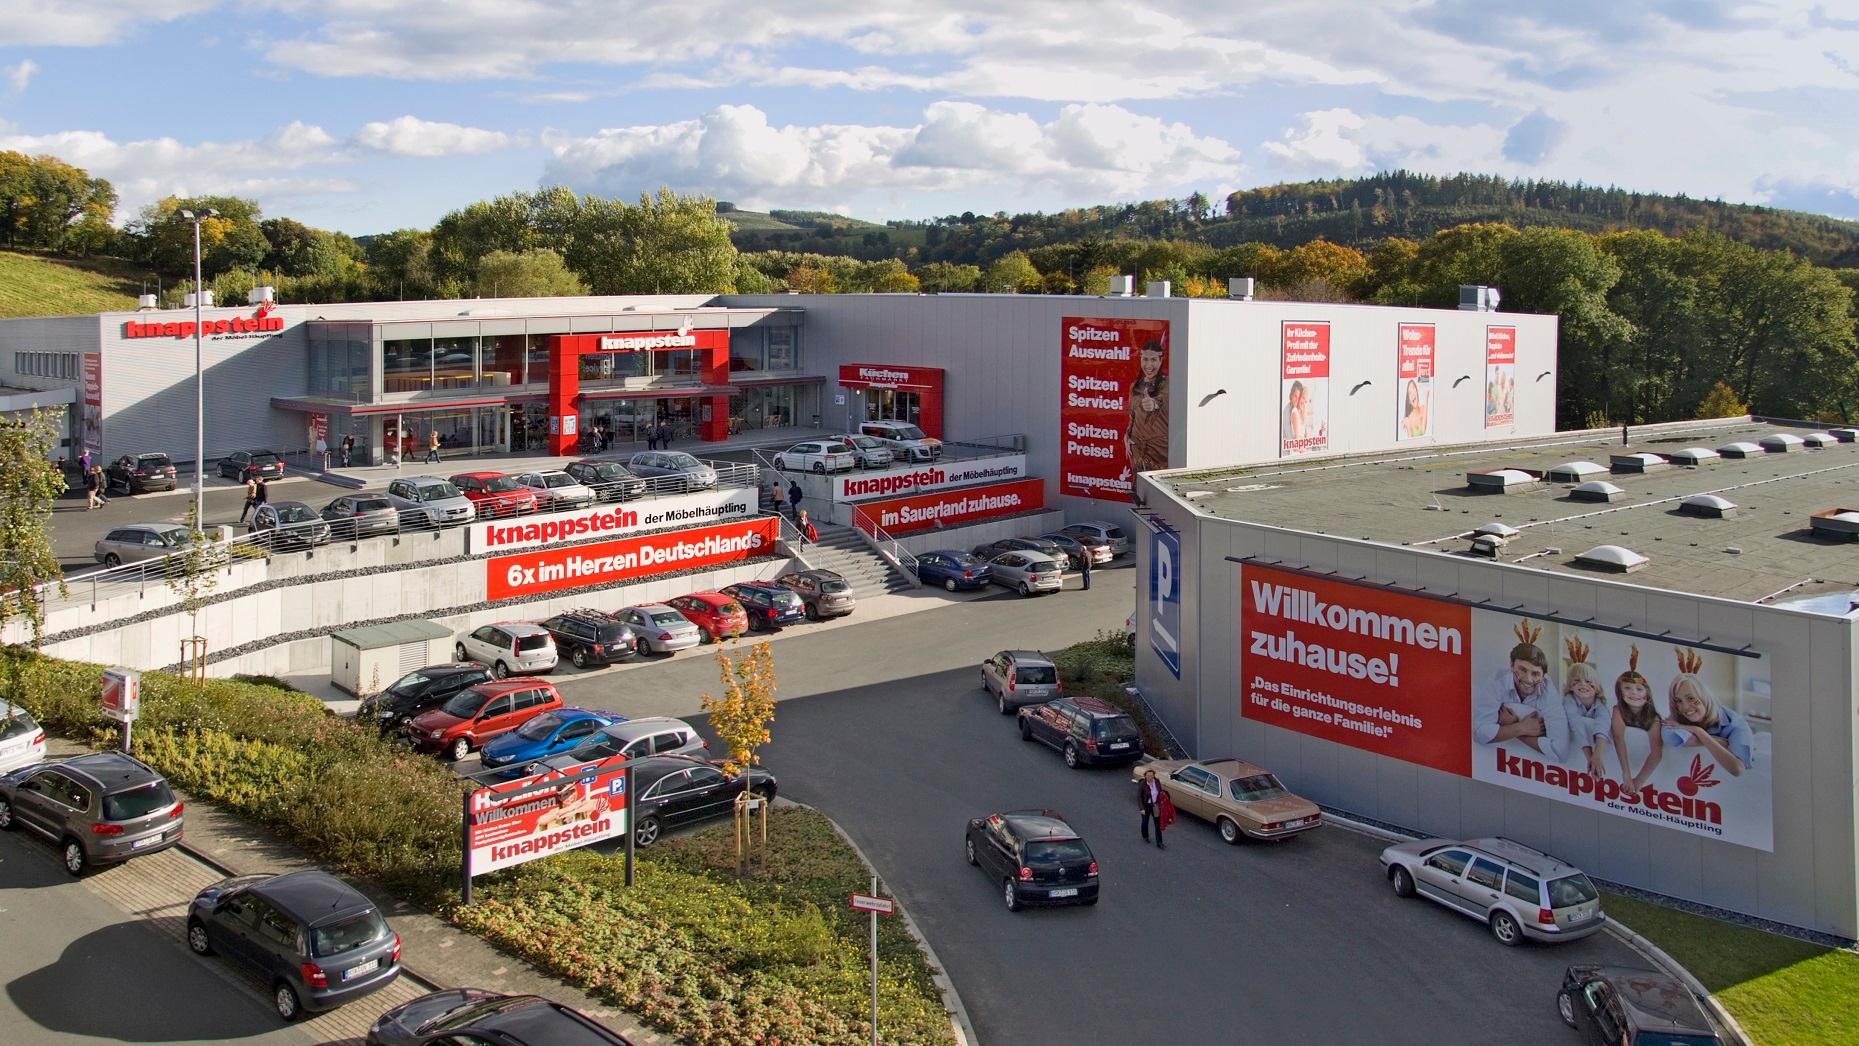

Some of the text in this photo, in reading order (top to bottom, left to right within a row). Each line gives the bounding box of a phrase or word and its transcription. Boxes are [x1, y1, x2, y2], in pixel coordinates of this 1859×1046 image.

[126, 308, 284, 338] knappstein
[1068, 326, 1119, 342] Spitzen
[601, 327, 696, 351] knappstein
[1068, 344, 1130, 360] Auswahl!
[859, 368, 908, 379] Küchen
[1068, 375, 1118, 391] Spitzen
[1068, 393, 1123, 410] Service!
[1068, 422, 1118, 440] Spitzen
[1283, 433, 1326, 449] knappstein
[1067, 441, 1114, 459] Preise!
[844, 465, 1018, 496] knappstein der Möbelhäuptling
[1067, 472, 1132, 490] knappstein
[486, 502, 746, 546] knappstein der Möbelhäuptling
[881, 493, 1021, 527] im Sauerland zuhause.
[507, 530, 762, 587] 6x im Herzen Deutschlands
[1158, 539, 1172, 616] P
[1250, 579, 1462, 656] Willkommen
[1250, 630, 1399, 688] zuhause!
[1250, 692, 1270, 707] für
[1271, 698, 1290, 713] die
[1293, 705, 1332, 725] ganze
[1281, 682, 1423, 729] Einrichtungserlebnis
[1496, 747, 1722, 824] knappstein
[475, 796, 557, 826] Willkommen
[1607, 801, 1722, 836] der Möbel-Häuptling
[491, 815, 611, 862] knappstein
